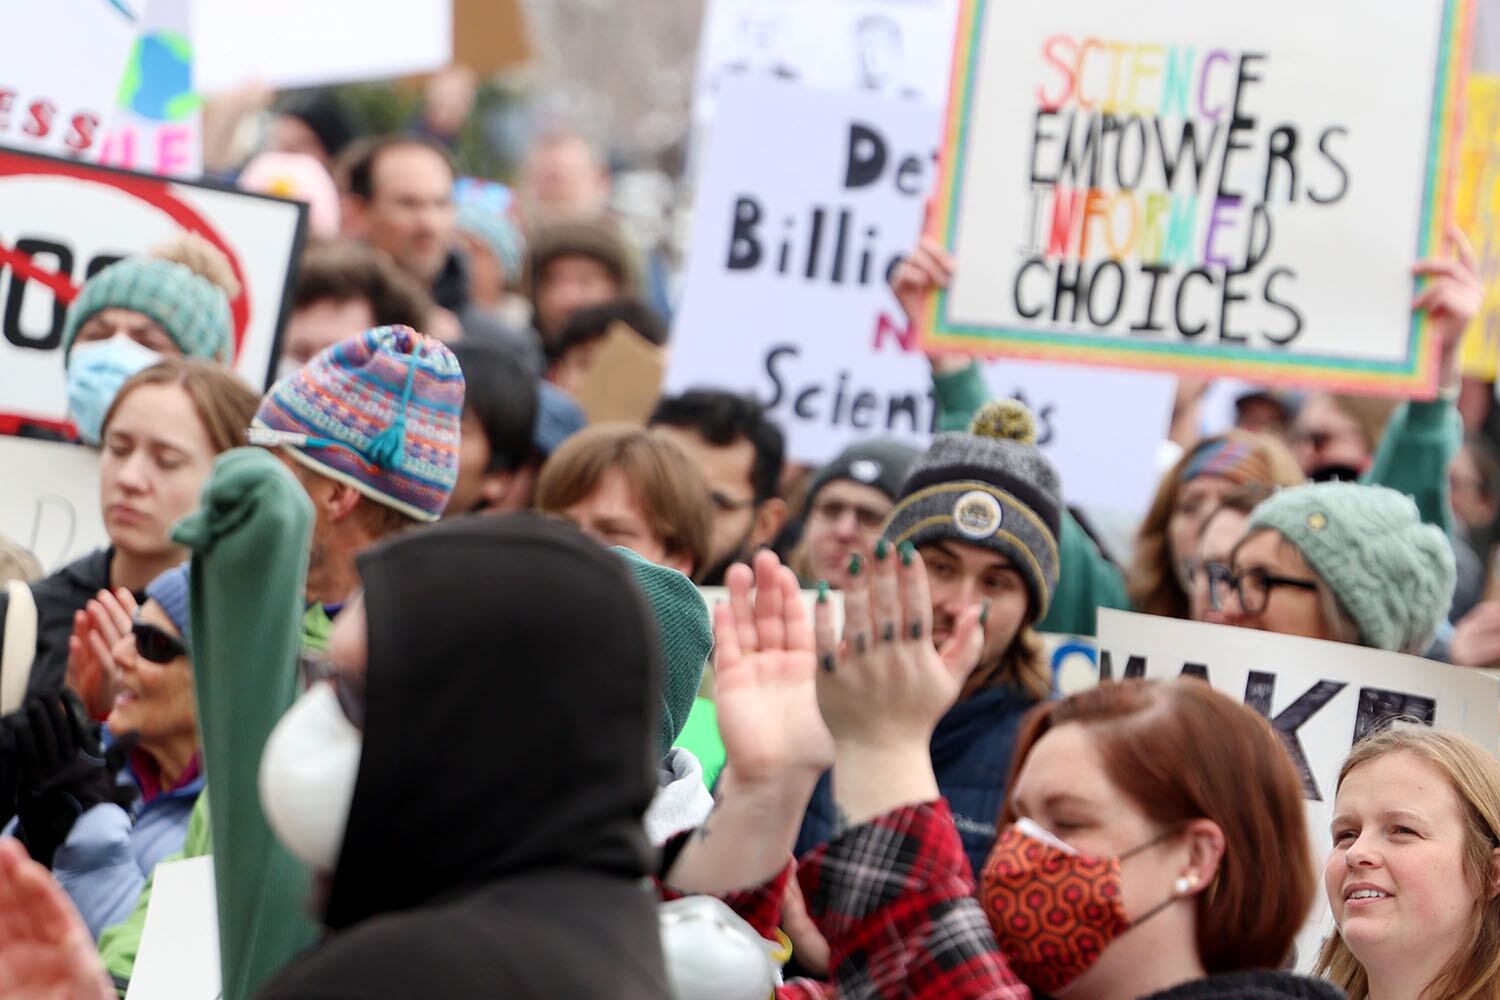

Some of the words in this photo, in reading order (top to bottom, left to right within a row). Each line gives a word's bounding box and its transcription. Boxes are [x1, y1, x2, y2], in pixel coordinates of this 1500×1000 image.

[1036, 35, 1268, 124] SCIENCE
[1030, 108, 1350, 204] EMPOWERS
[1022, 186, 1274, 272] INFORMED
[1014, 258, 1305, 346] CHOICES
